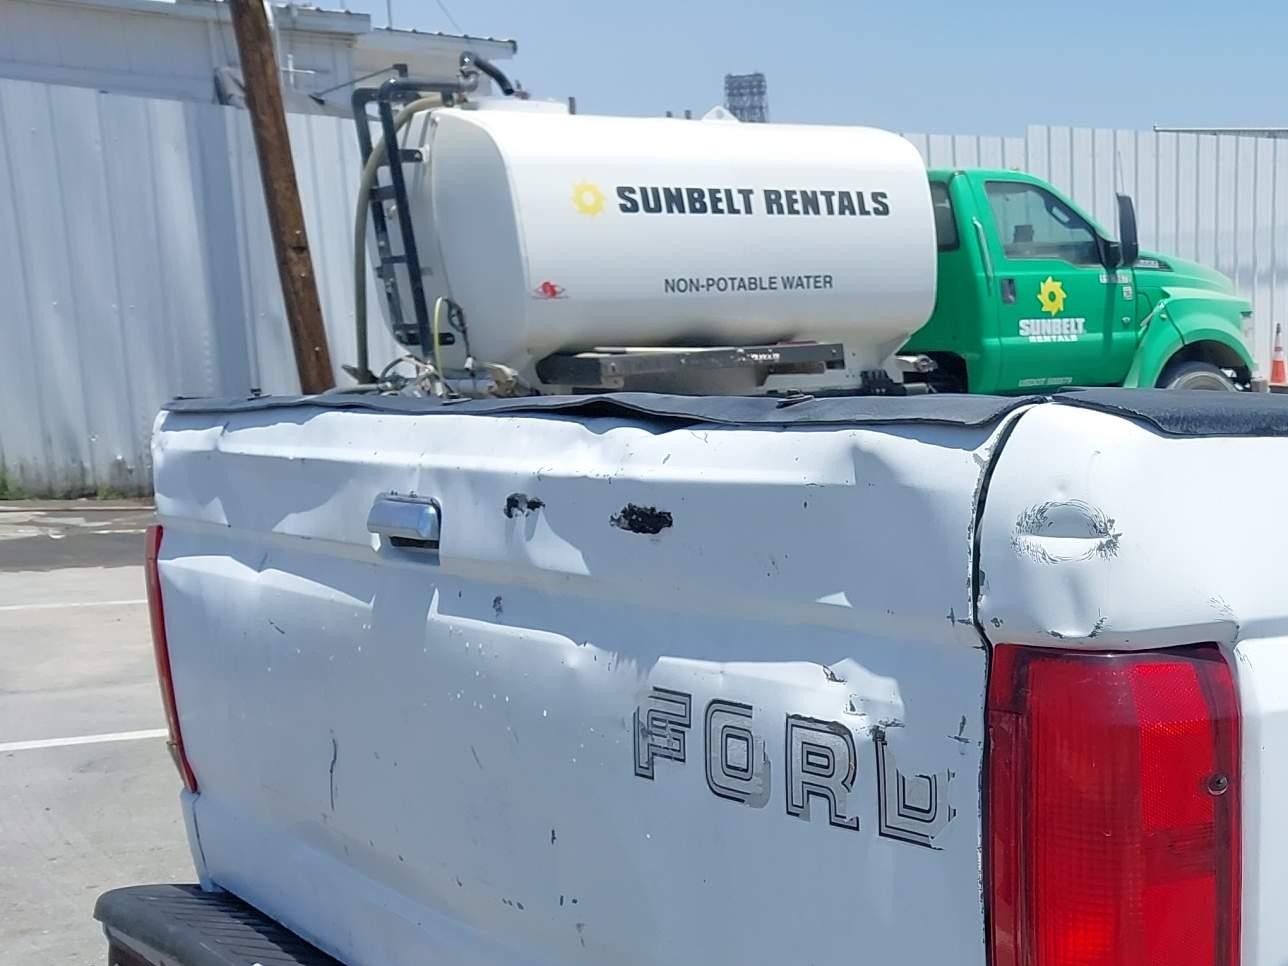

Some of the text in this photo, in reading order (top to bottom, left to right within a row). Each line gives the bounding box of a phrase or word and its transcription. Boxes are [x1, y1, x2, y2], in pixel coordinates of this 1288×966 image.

[616, 186, 890, 216] SUNBELT RENTALS
[664, 274, 834, 294] NON-POTABLE WATER
[1018, 318, 1086, 337] SUNBELT
[1028, 335, 1078, 343] RENTALS
[633, 687, 958, 850] FORD
